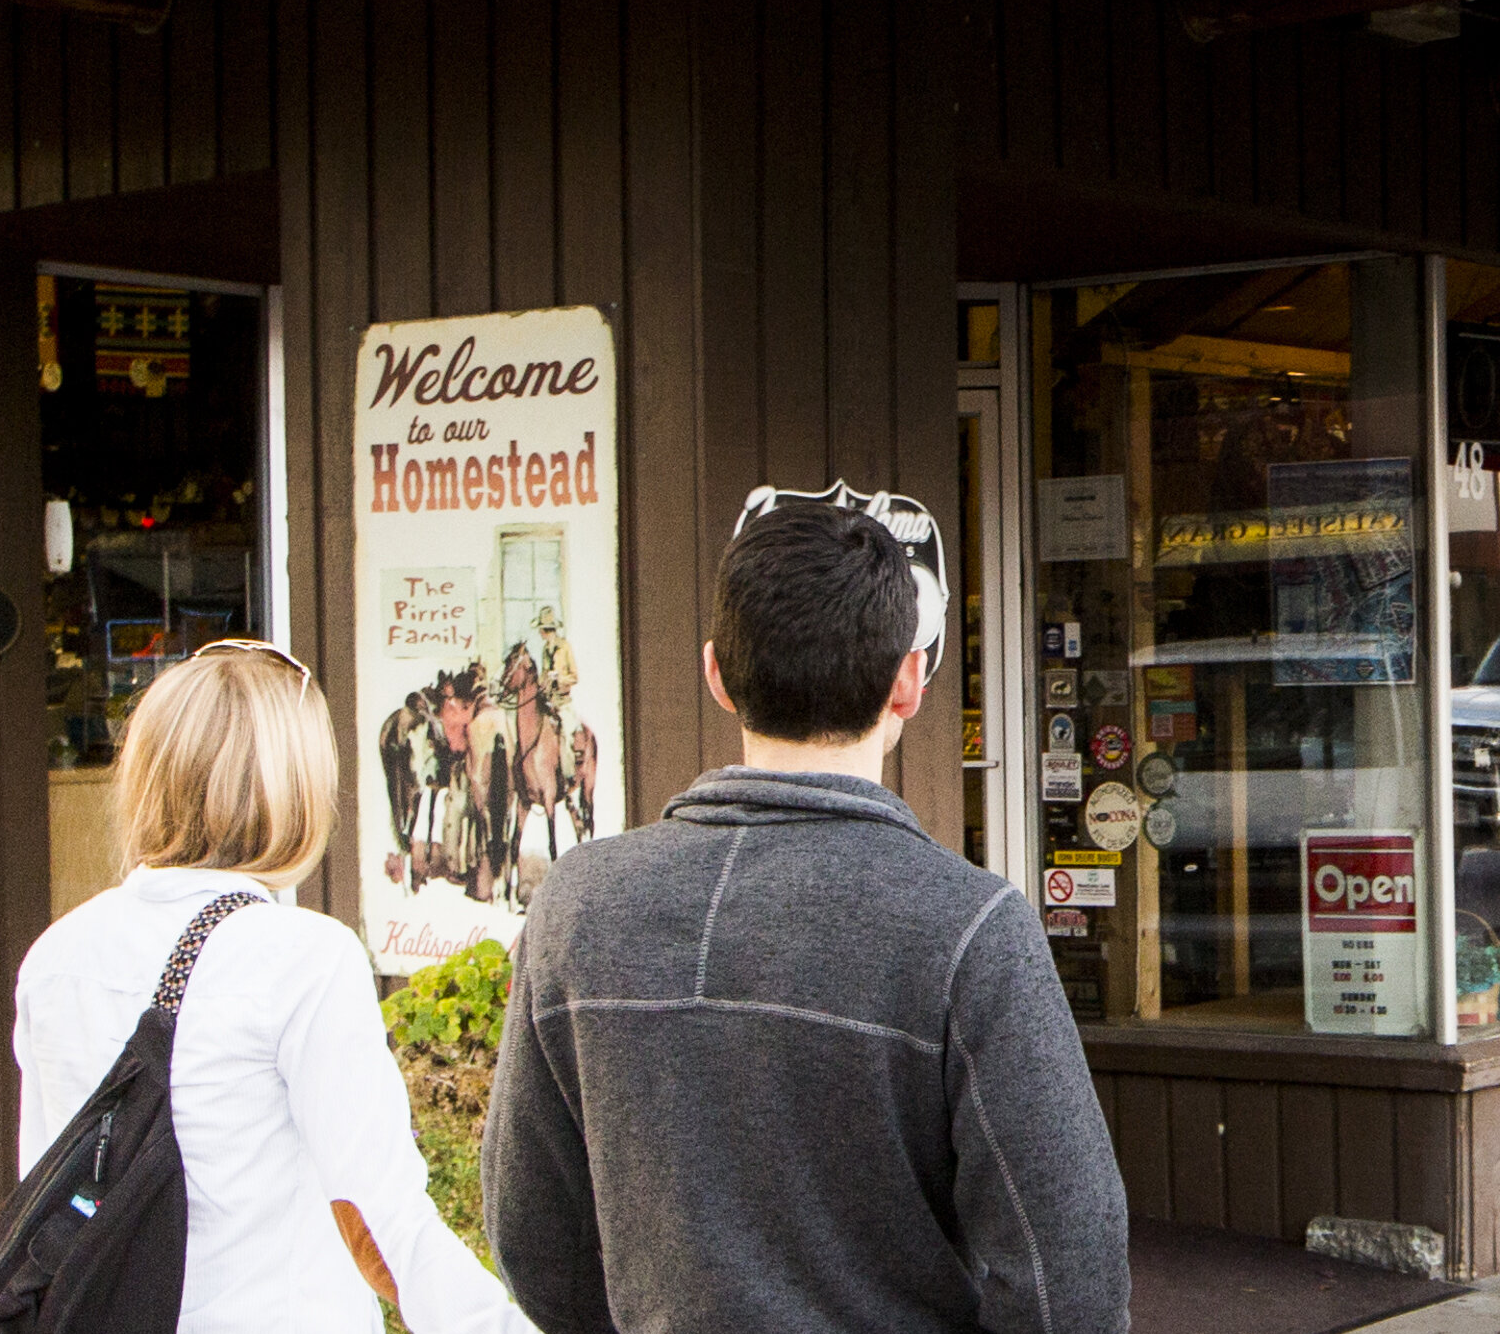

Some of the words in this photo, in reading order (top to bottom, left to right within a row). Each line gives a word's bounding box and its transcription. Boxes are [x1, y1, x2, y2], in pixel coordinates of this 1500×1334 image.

[369, 335, 599, 410] Welcome
[407, 415, 434, 445] to
[443, 418, 490, 443] our
[370, 431, 599, 513] Homestead
[1453, 441, 1487, 501] 48
[403, 577, 455, 598] The
[393, 600, 466, 622] Pirrie
[387, 625, 474, 650] Family
[1314, 864, 1415, 911] Open
